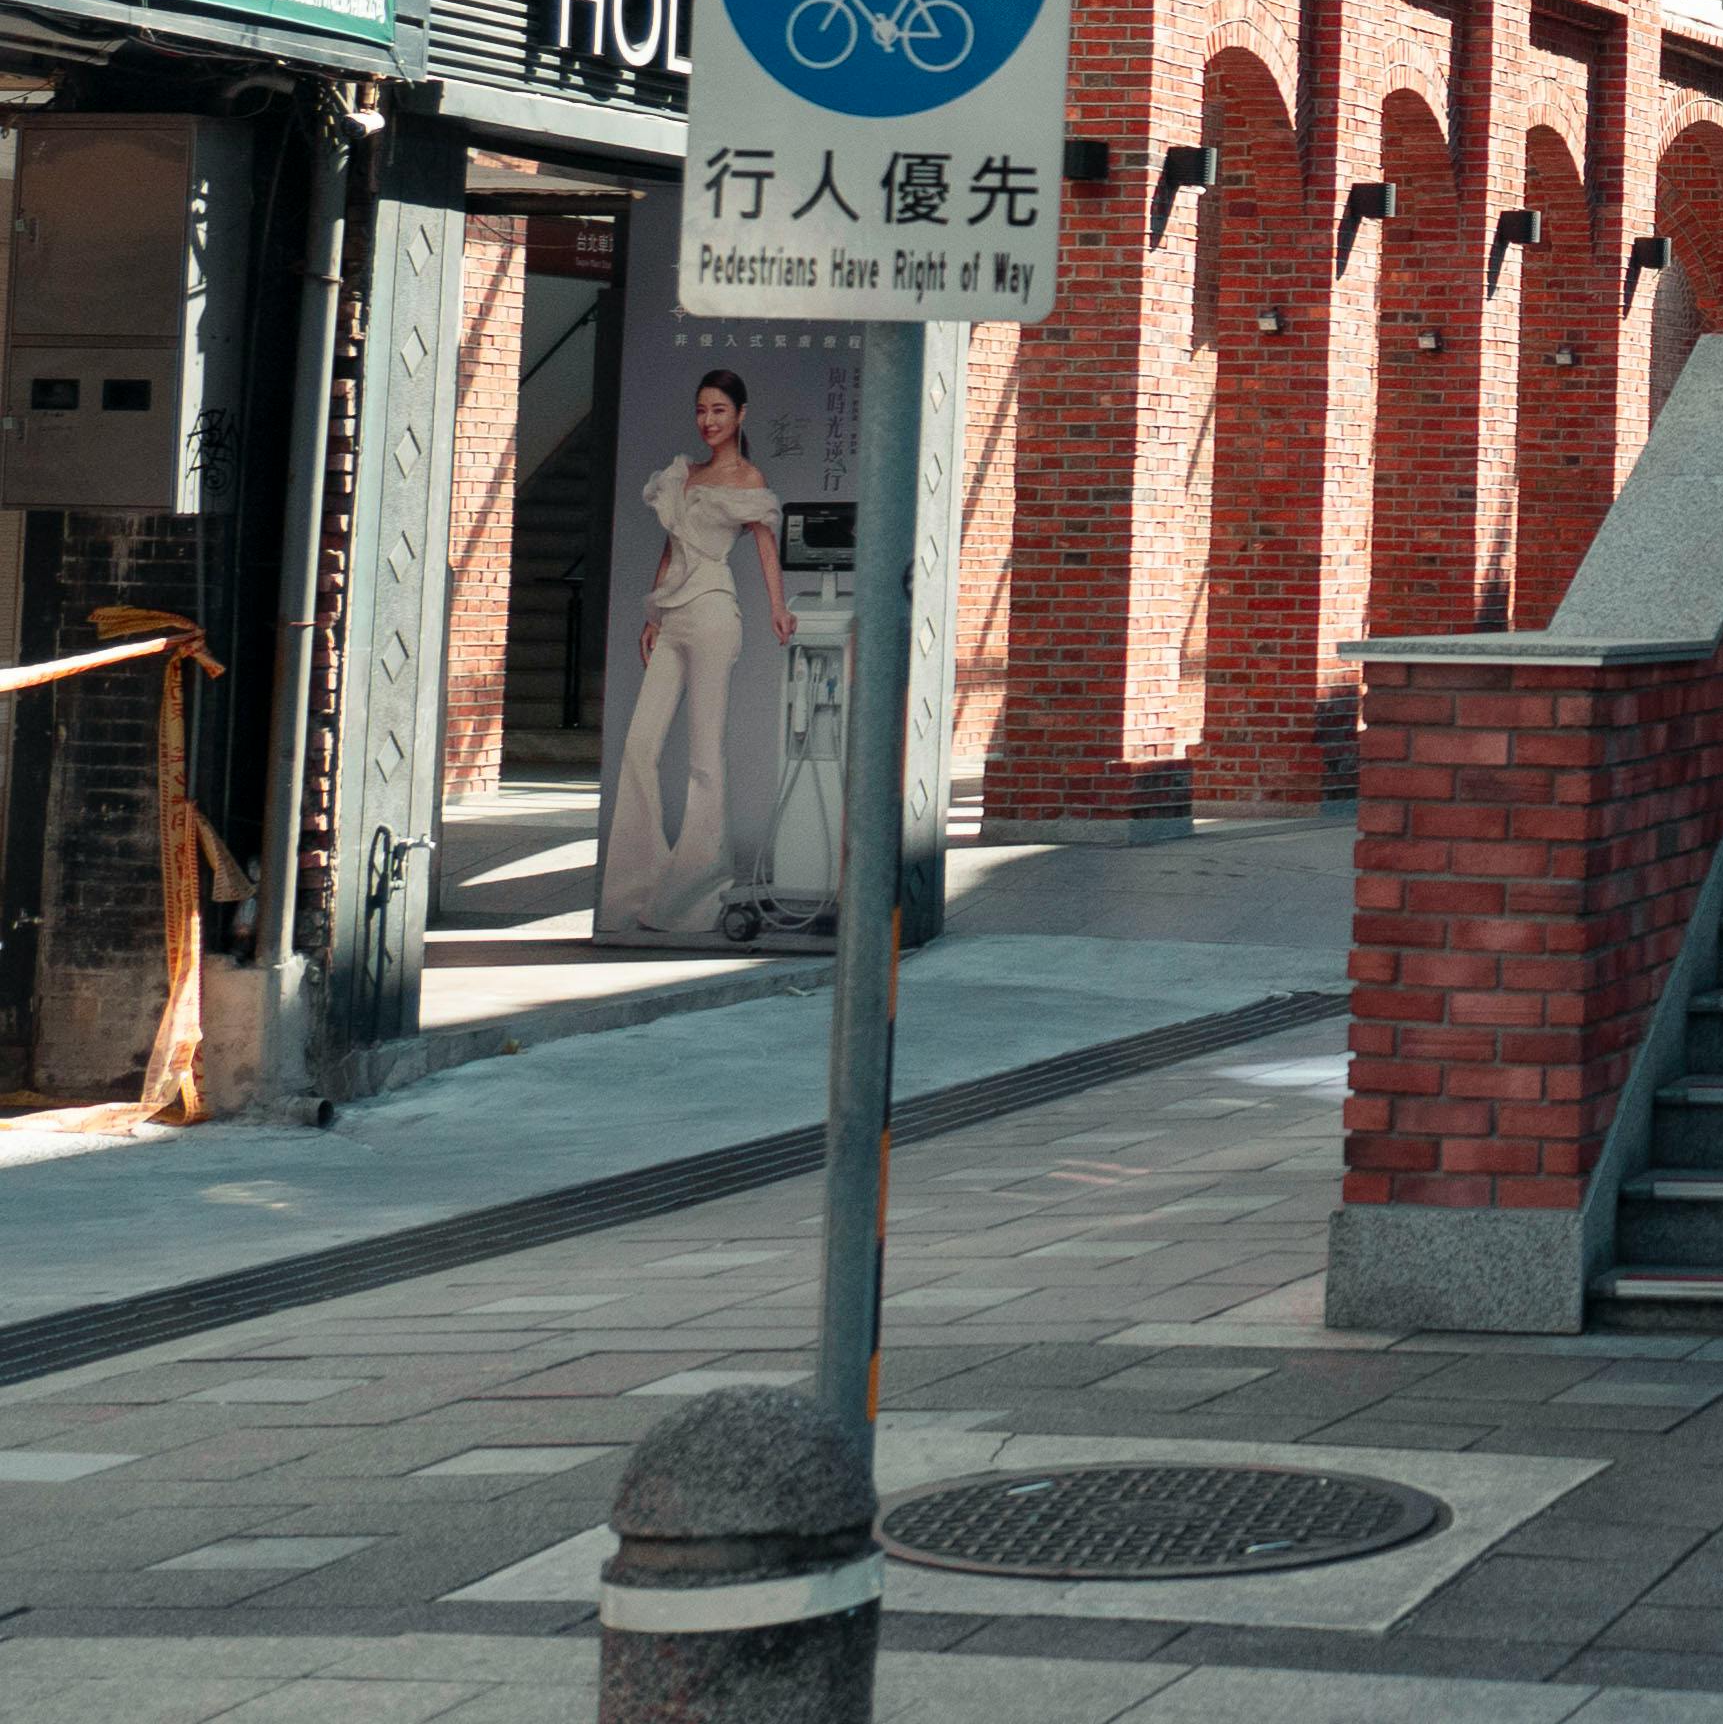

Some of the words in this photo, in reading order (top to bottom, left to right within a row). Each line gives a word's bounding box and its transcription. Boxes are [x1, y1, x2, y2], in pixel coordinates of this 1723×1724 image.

[704, 146, 1039, 228] 行人優先
[701, 243, 818, 288] Pedestrians
[831, 246, 879, 289] Have
[893, 249, 946, 305] Right
[960, 251, 981, 292] of
[994, 251, 1035, 305] Way
